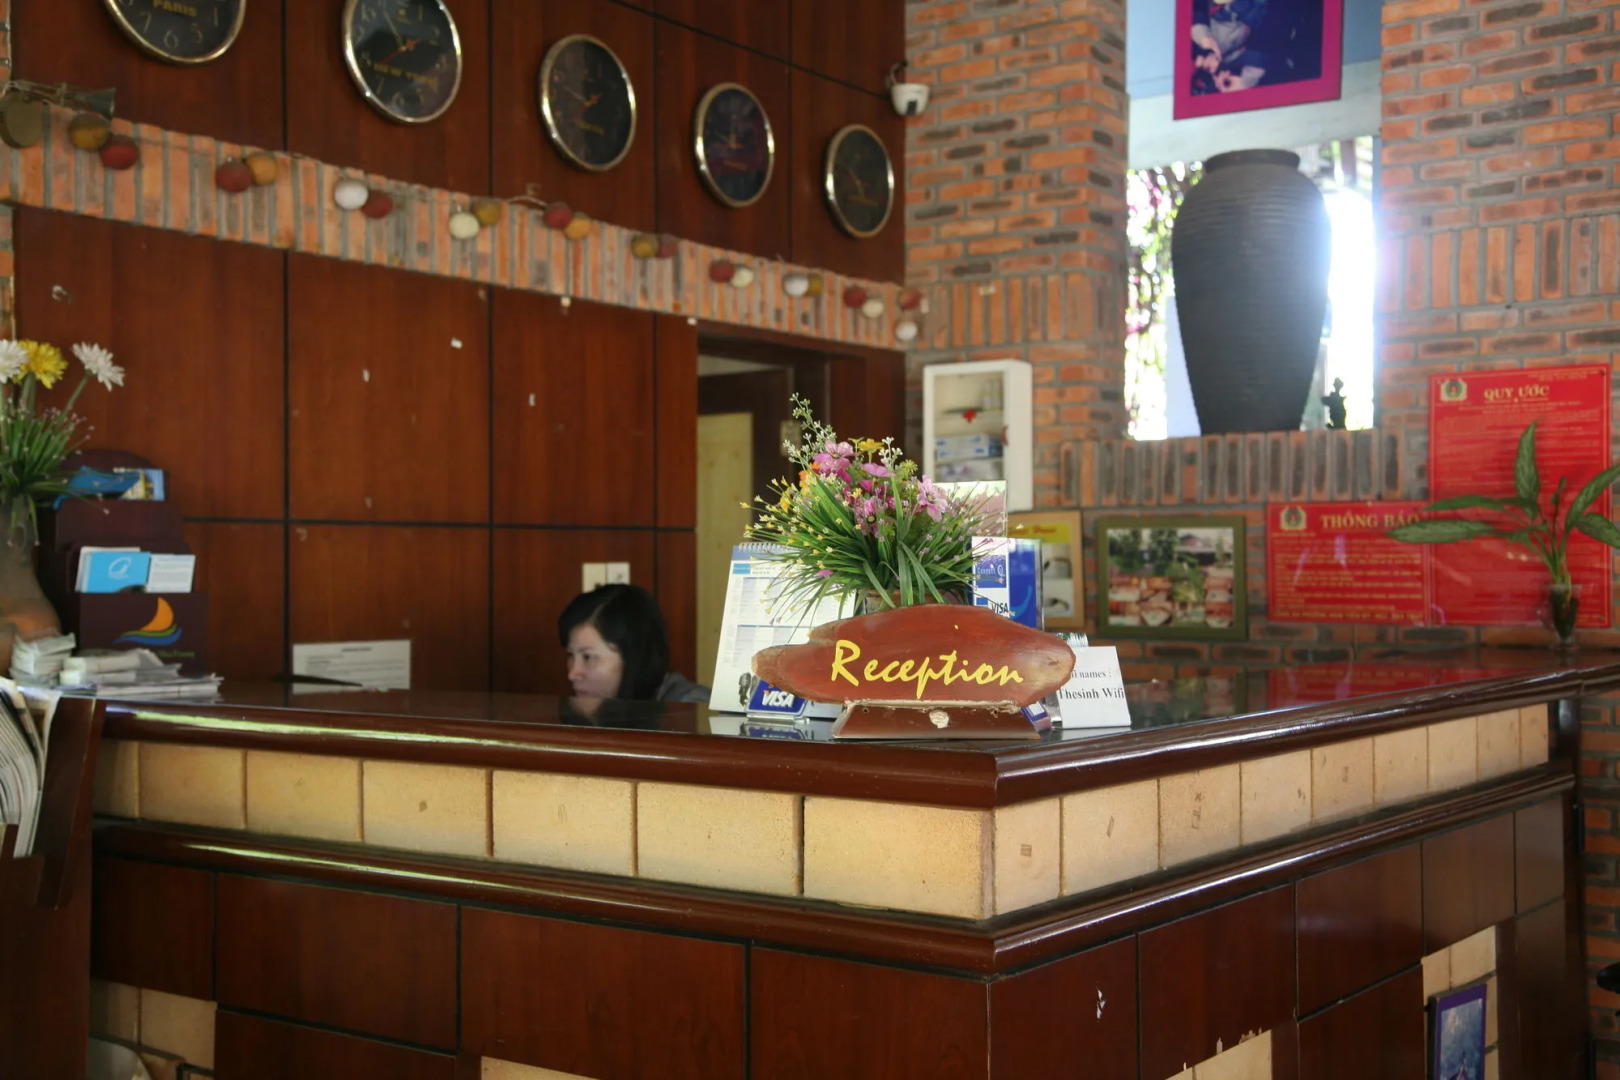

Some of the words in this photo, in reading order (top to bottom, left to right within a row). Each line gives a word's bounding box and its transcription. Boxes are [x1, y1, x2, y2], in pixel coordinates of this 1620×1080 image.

[153, 0, 197, 17] PARIS
[163, 29, 178, 49] 6
[1483, 386, 1514, 401] QUY
[1320, 509, 1378, 529] THÔNG
[990, 602, 1009, 615] VISA
[830, 639, 1024, 699] Reception
[1079, 671, 1107, 679] names
[761, 689, 795, 708] VISA
[1101, 687, 1125, 699] Wifi
